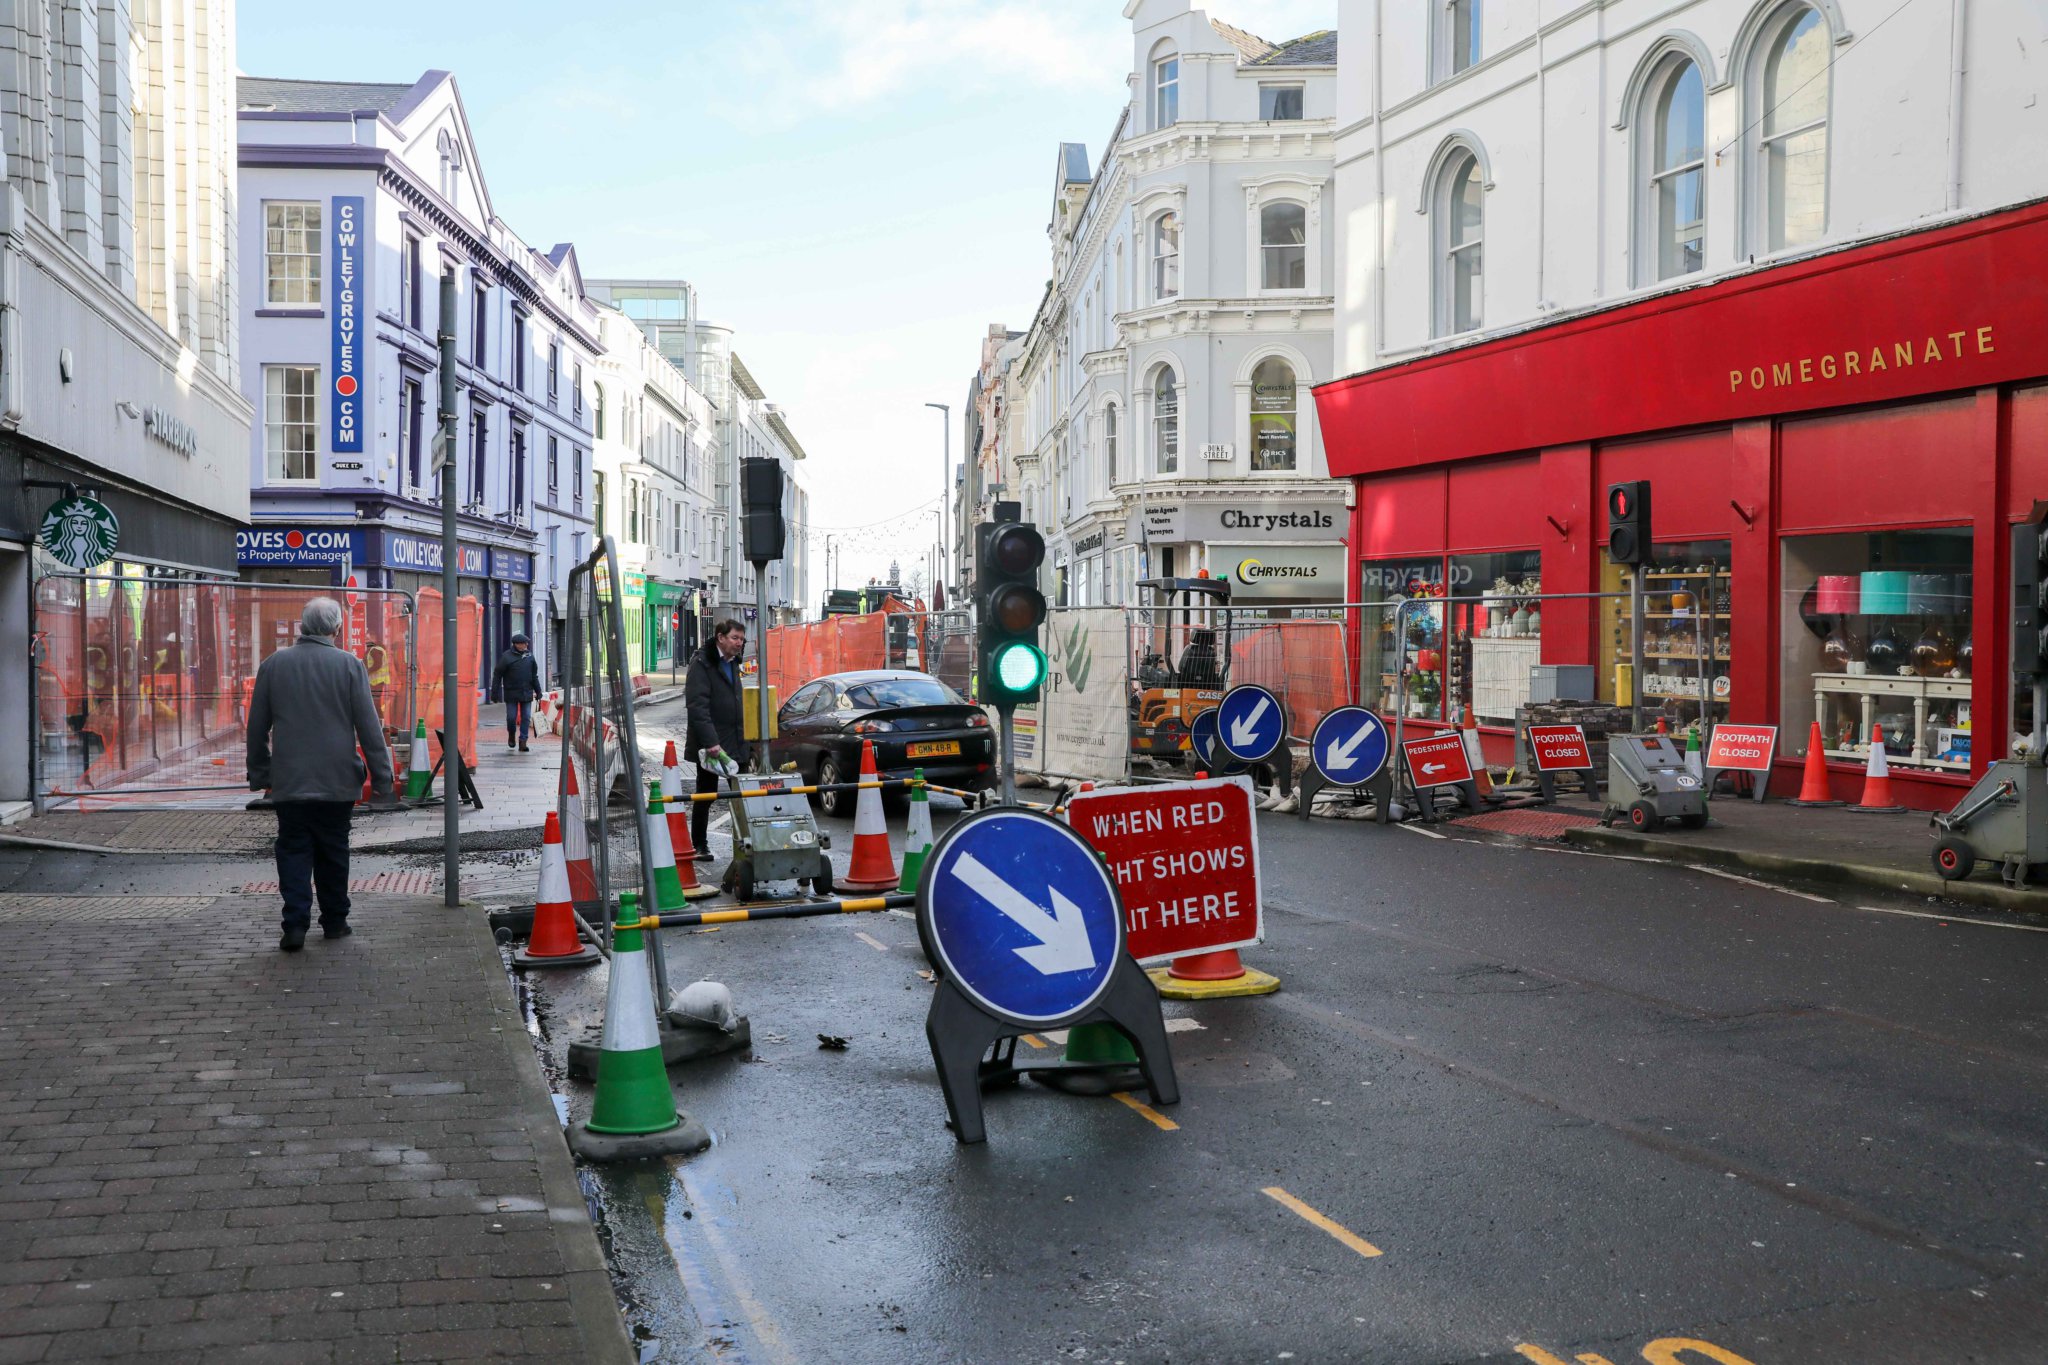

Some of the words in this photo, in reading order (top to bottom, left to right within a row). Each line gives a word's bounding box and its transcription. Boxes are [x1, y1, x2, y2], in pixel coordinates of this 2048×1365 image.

[1729, 326, 1995, 393] POMEGRANATE
[1220, 509, 1332, 531] Chrystals
[305, 532, 351, 549] COM
[249, 550, 296, 563] Property
[466, 550, 482, 572] COM
[1249, 566, 1317, 577] CHRYSTALS
[1197, 691, 1223, 700] CASE
[1535, 734, 1582, 744] FOOTPATH
[1715, 733, 1771, 744] FOOTPATH
[1408, 741, 1459, 755] PEDESTRIANS
[1545, 748, 1581, 758] CLOSED
[1719, 748, 1761, 758] CLOSED
[1092, 808, 1163, 839] WHEN
[1172, 801, 1225, 829] RED
[1152, 845, 1246, 879] SHOWS
[1160, 890, 1240, 928] HERE
